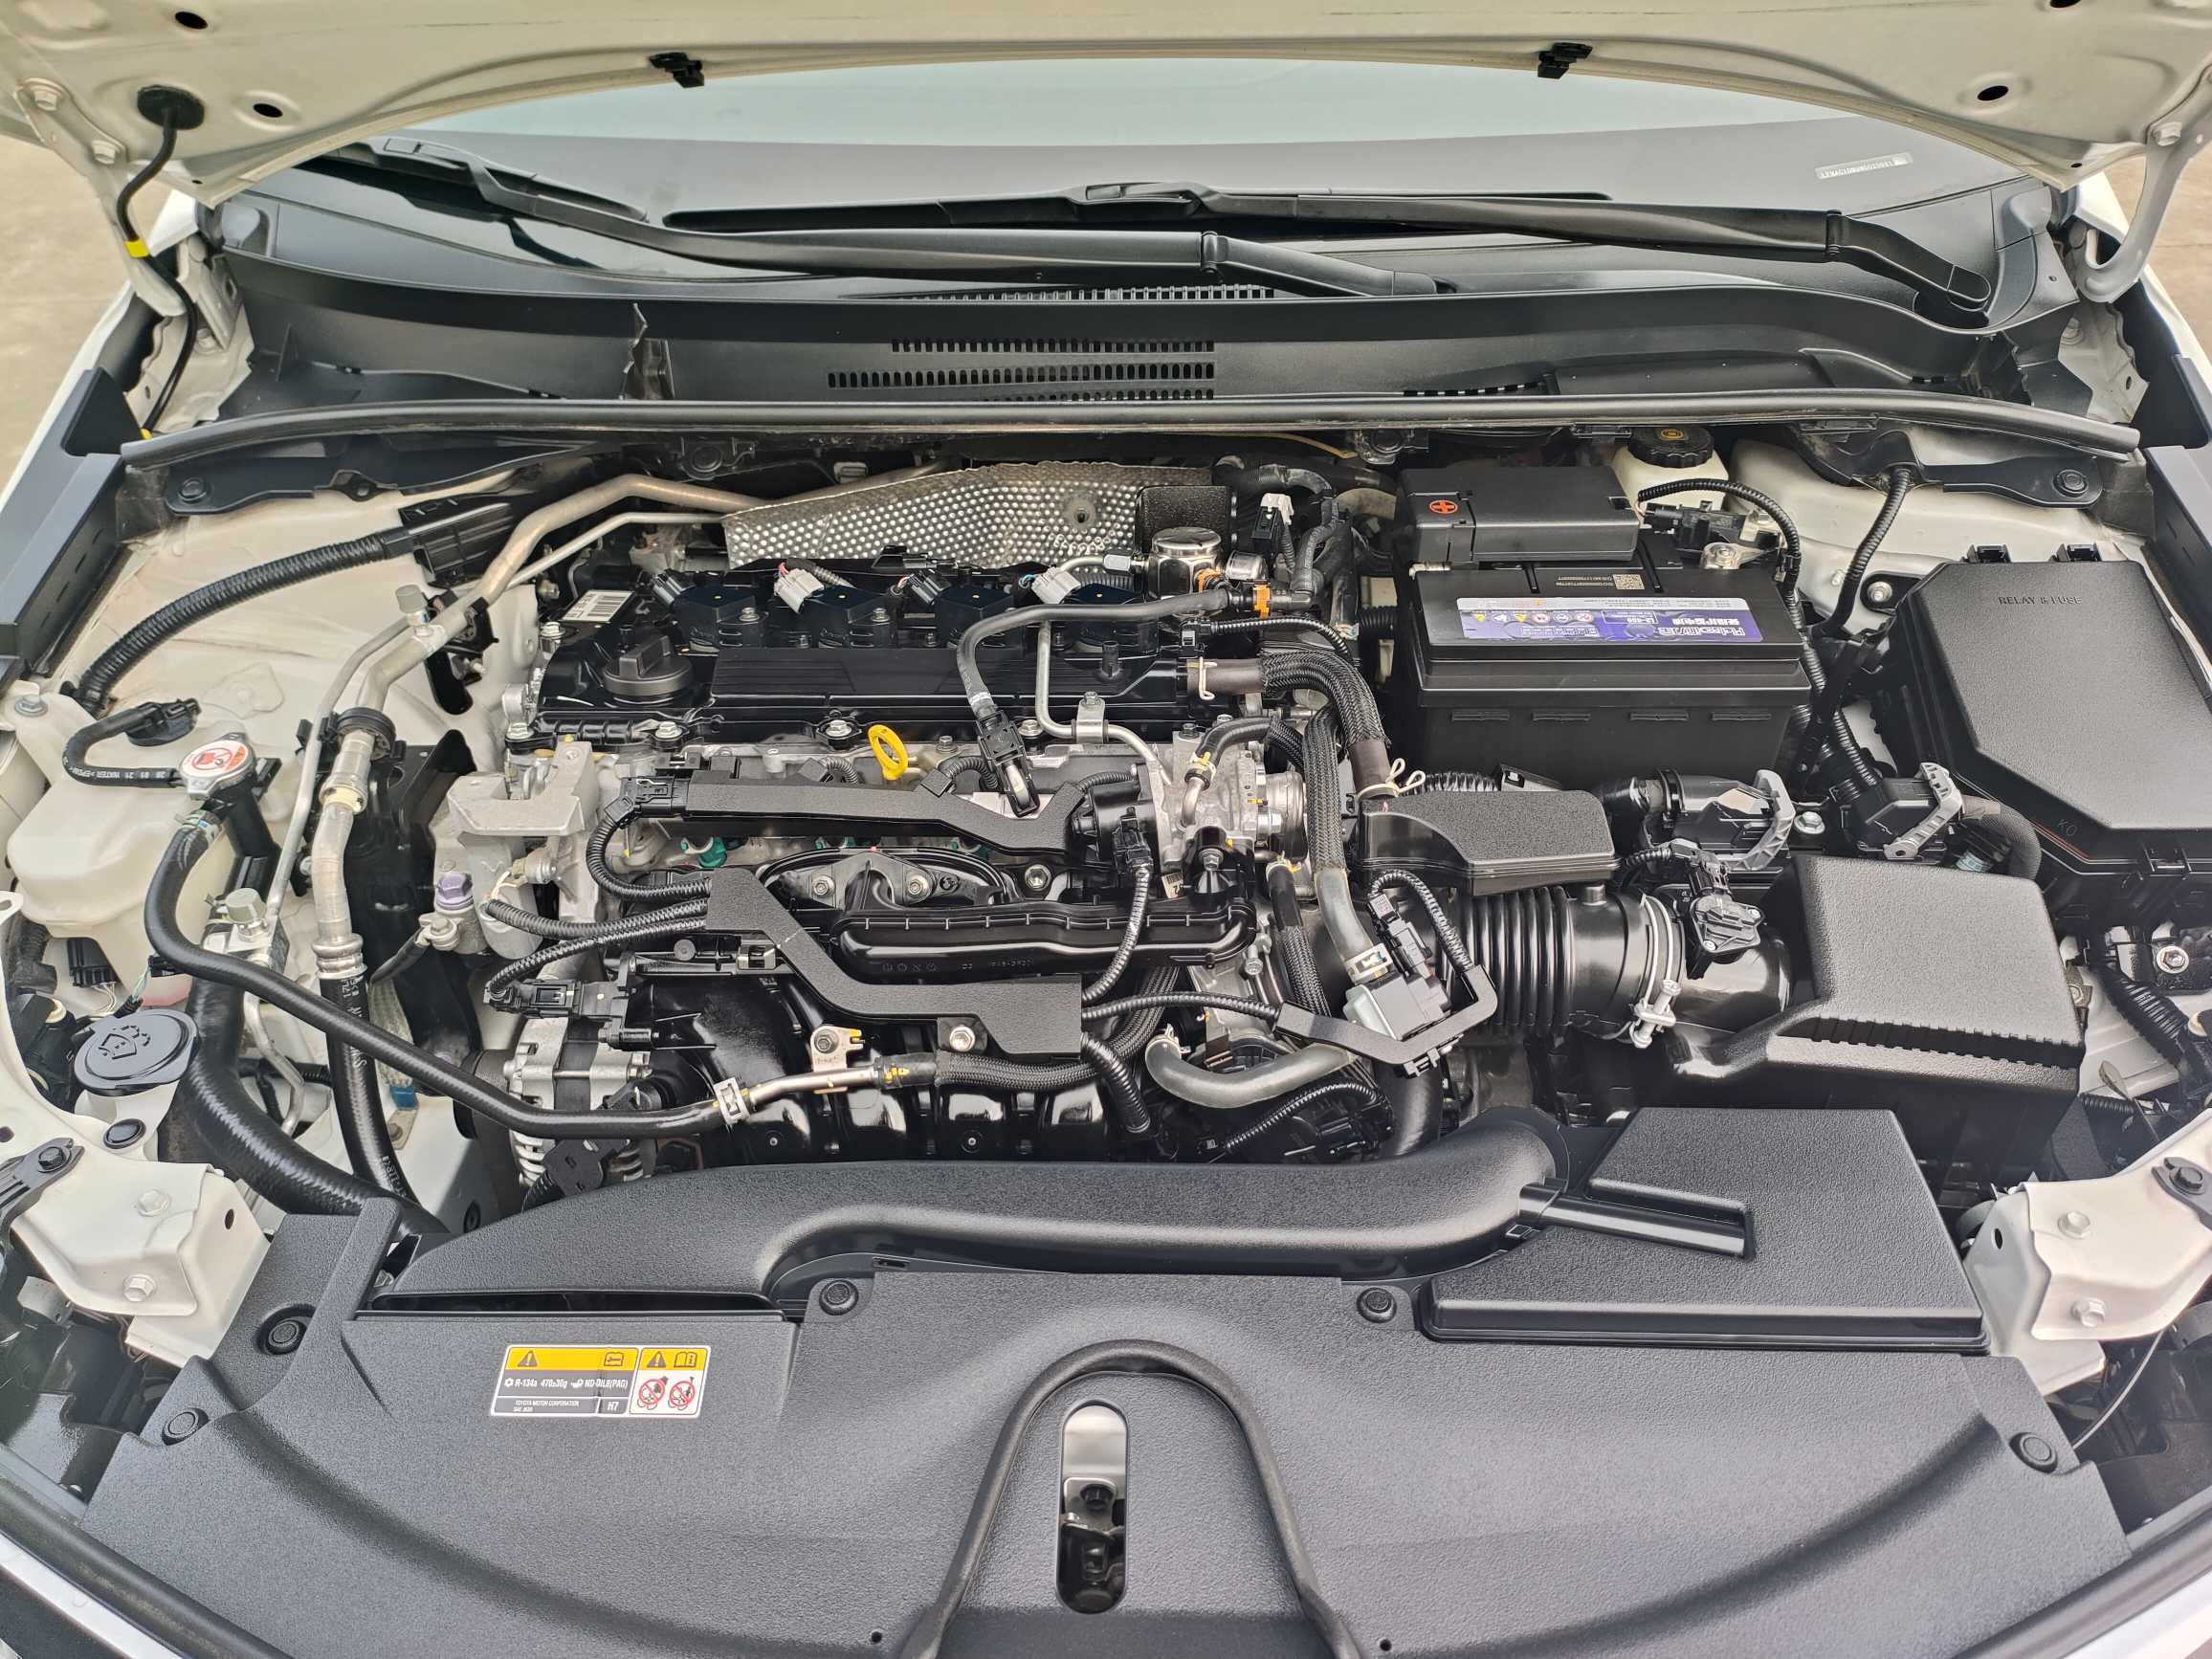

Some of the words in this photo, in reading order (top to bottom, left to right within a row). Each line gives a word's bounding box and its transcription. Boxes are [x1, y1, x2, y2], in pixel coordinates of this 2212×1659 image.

[1998, 596, 2036, 606] RELAY
[2040, 596, 2048, 606] &
[2050, 596, 2083, 606] FUSE
